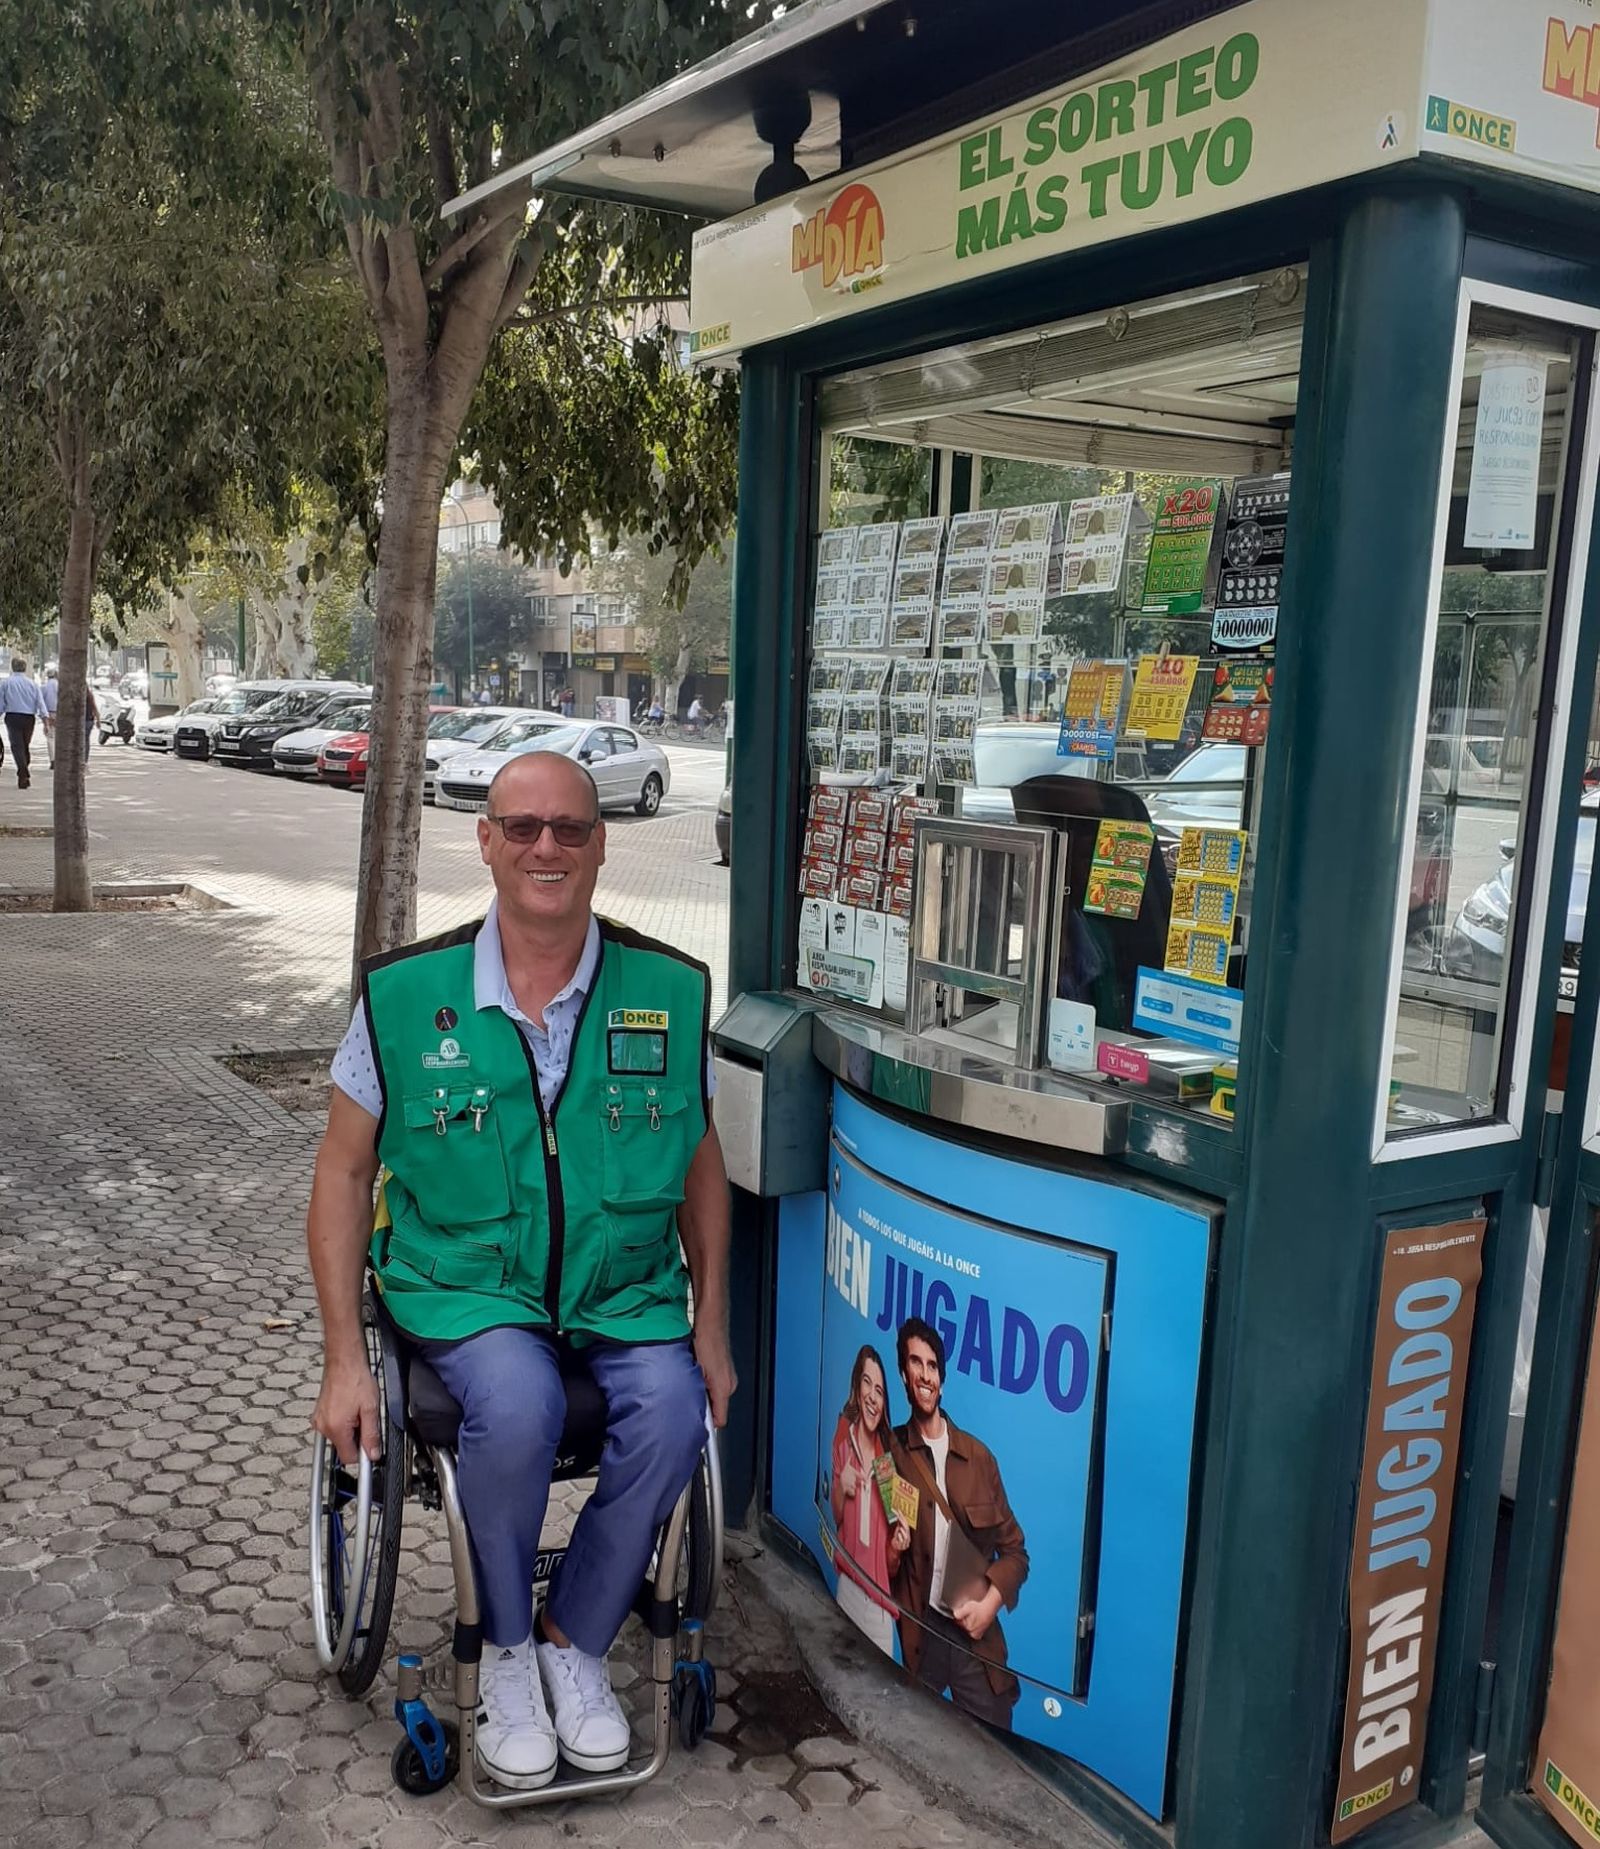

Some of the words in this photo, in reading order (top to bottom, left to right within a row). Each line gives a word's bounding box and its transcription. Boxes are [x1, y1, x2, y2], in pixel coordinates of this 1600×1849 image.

[960, 126, 1014, 191] EL
[1023, 32, 1259, 166] SORTEO
[1453, 109, 1512, 148] ONCE
[956, 171, 1069, 259] MÁS
[1081, 117, 1253, 219] TUYO
[792, 208, 826, 273] MI
[823, 196, 883, 288] DÍA
[701, 324, 731, 347] ONCE
[625, 1012, 664, 1025] ONCE
[862, 1208, 880, 1231] TODOS
[880, 1221, 892, 1240] LOS
[892, 1229, 907, 1248] QUE
[907, 1236, 935, 1260] JUGÁIS
[935, 1249, 942, 1264] A
[943, 1252, 954, 1269] LA
[955, 1257, 981, 1279] ONCE
[827, 1201, 872, 1319] BIEN
[876, 1254, 1090, 1414] JUGADO
[1369, 1277, 1462, 1572] JUGADO
[1354, 1587, 1427, 1772] BIEN
[1356, 1783, 1391, 1808] ONCE
[1563, 1784, 1600, 1837] ONCE
